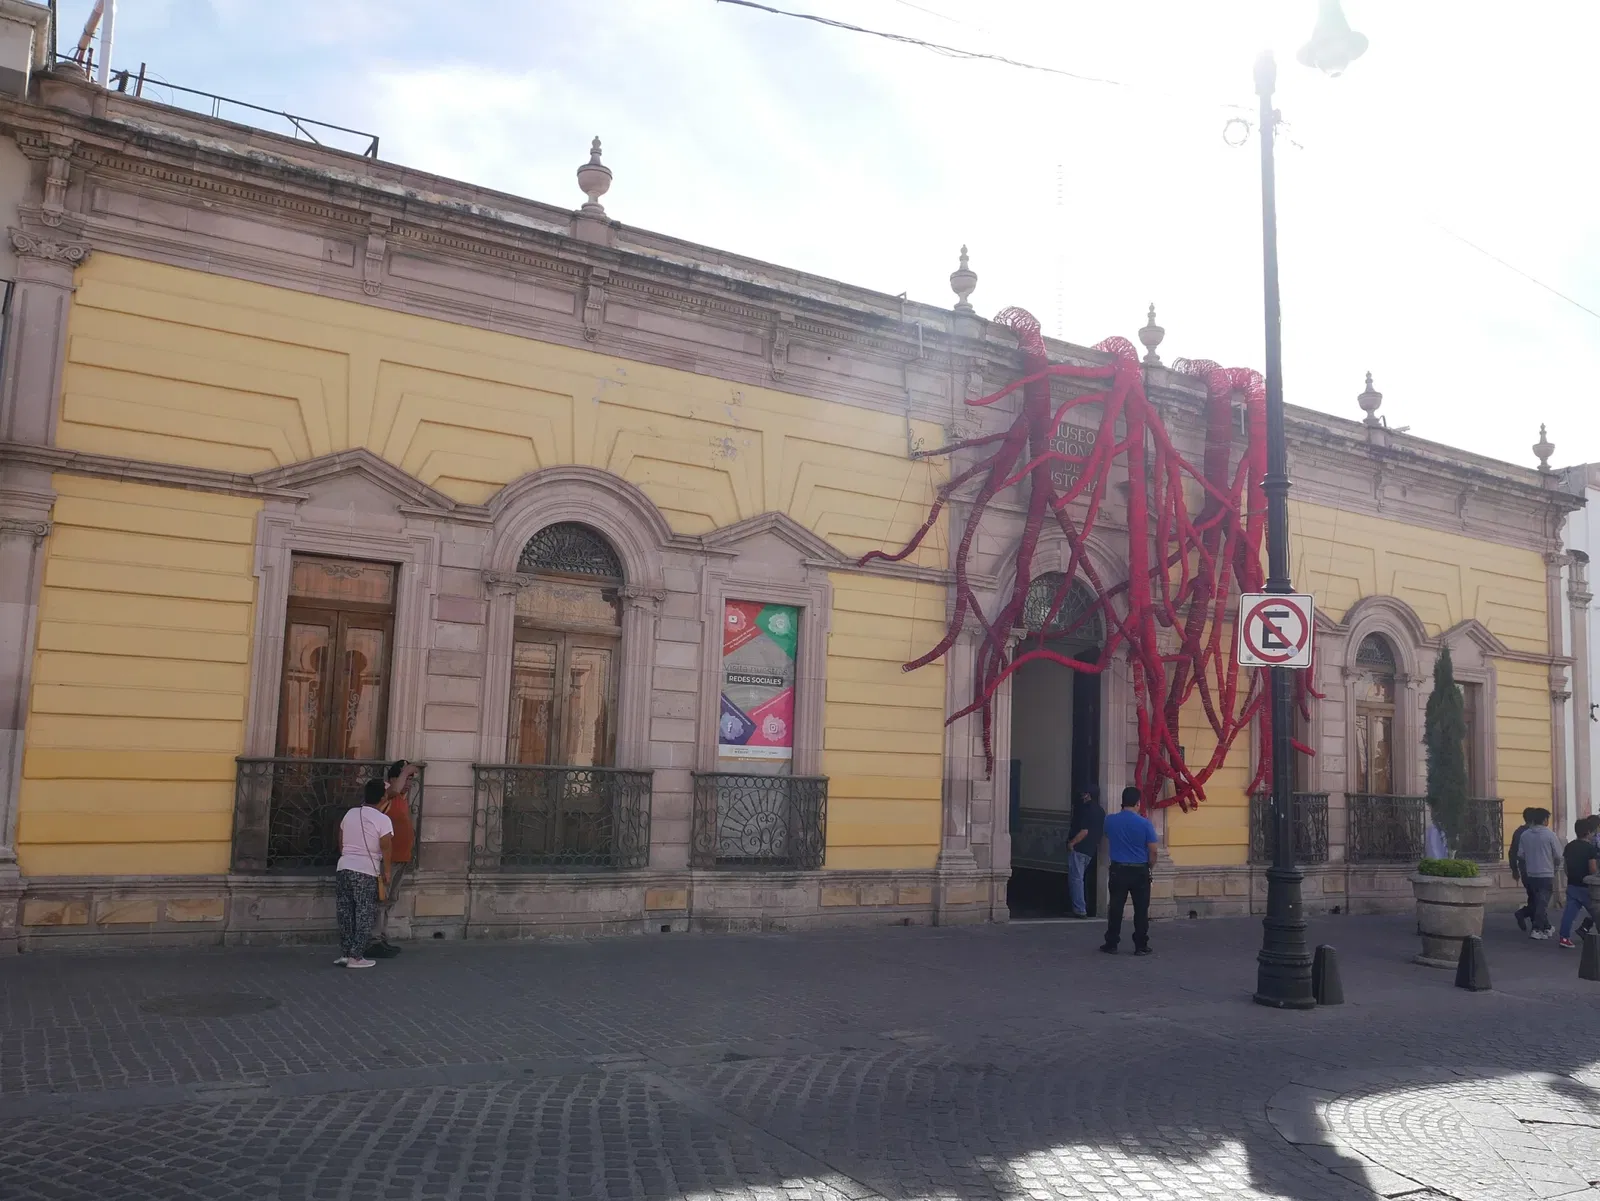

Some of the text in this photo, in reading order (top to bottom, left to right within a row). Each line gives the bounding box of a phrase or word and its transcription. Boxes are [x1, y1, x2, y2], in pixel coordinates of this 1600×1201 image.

[1049, 439, 1092, 457] EGION
[1050, 471, 1097, 492] ISTOI
[1262, 611, 1289, 649] E
[728, 675, 782, 685] REDES SOCIALES
